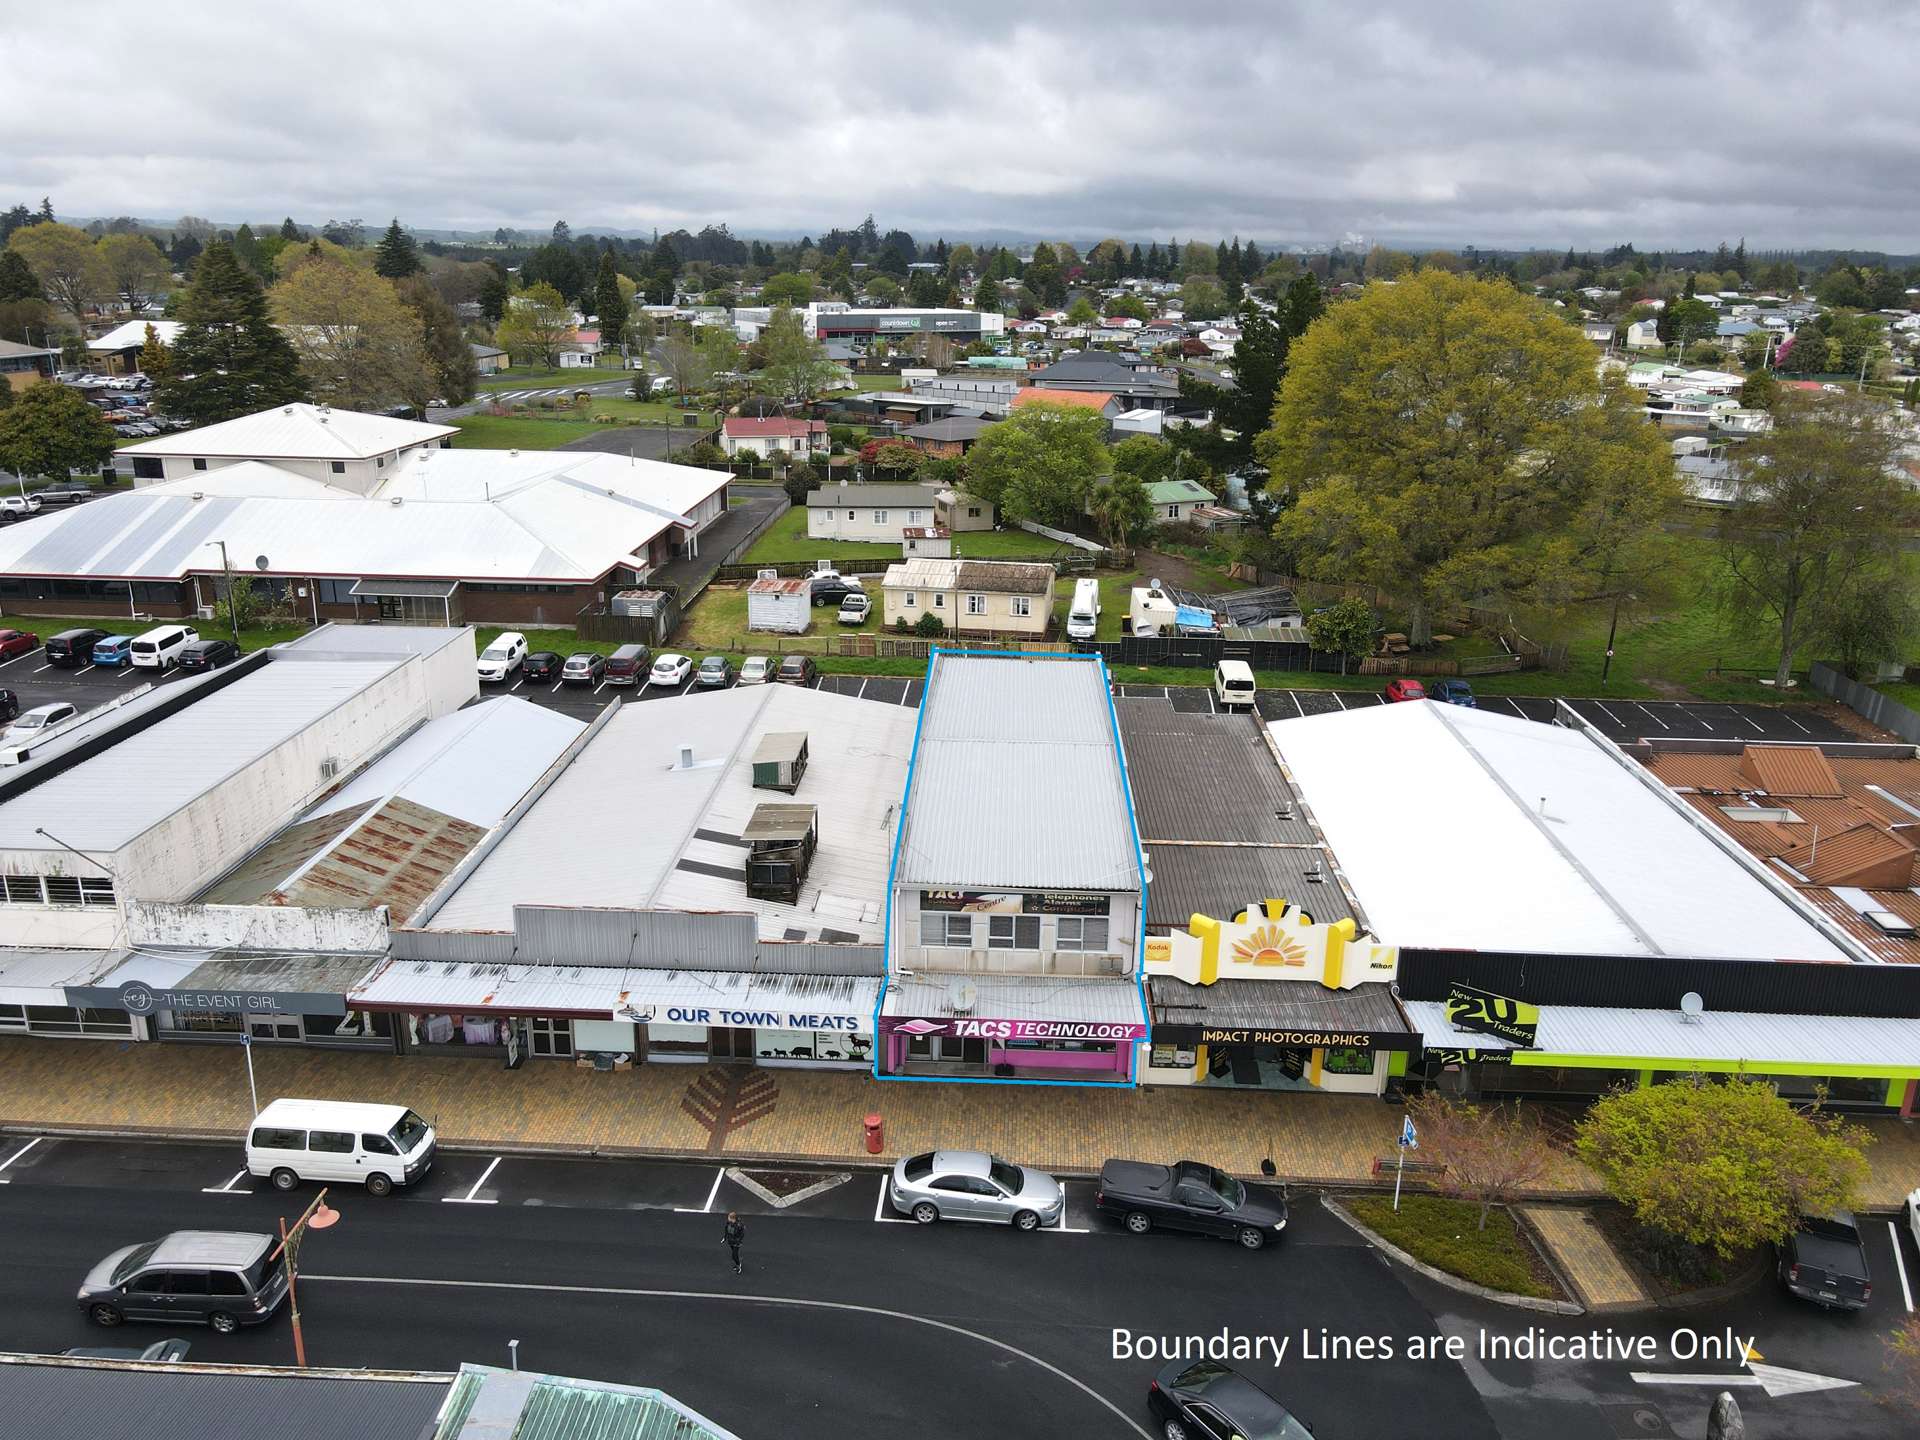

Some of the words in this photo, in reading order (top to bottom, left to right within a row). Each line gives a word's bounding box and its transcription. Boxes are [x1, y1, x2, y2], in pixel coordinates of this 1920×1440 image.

[881, 319, 910, 327] countdown
[1044, 893, 1105, 901] Telephones
[1370, 962, 1393, 970] Nikon
[164, 993, 194, 1007] THE
[197, 994, 243, 1008] EVENT
[247, 996, 281, 1009] GIRL
[1450, 988, 1473, 1001] New
[667, 1008, 711, 1024] OUR
[719, 1010, 780, 1027] TOWN
[788, 1014, 858, 1030] MEATS
[1449, 997, 1518, 1026] 2U
[953, 1020, 1012, 1038] TACS
[1016, 1022, 1136, 1038] TECHNOLOGY
[1493, 1020, 1534, 1040] Traders
[1202, 1030, 1250, 1043] IMPACT
[1254, 1031, 1370, 1046] PHOTOGRAPHICS
[1481, 1054, 1512, 1062] Traders
